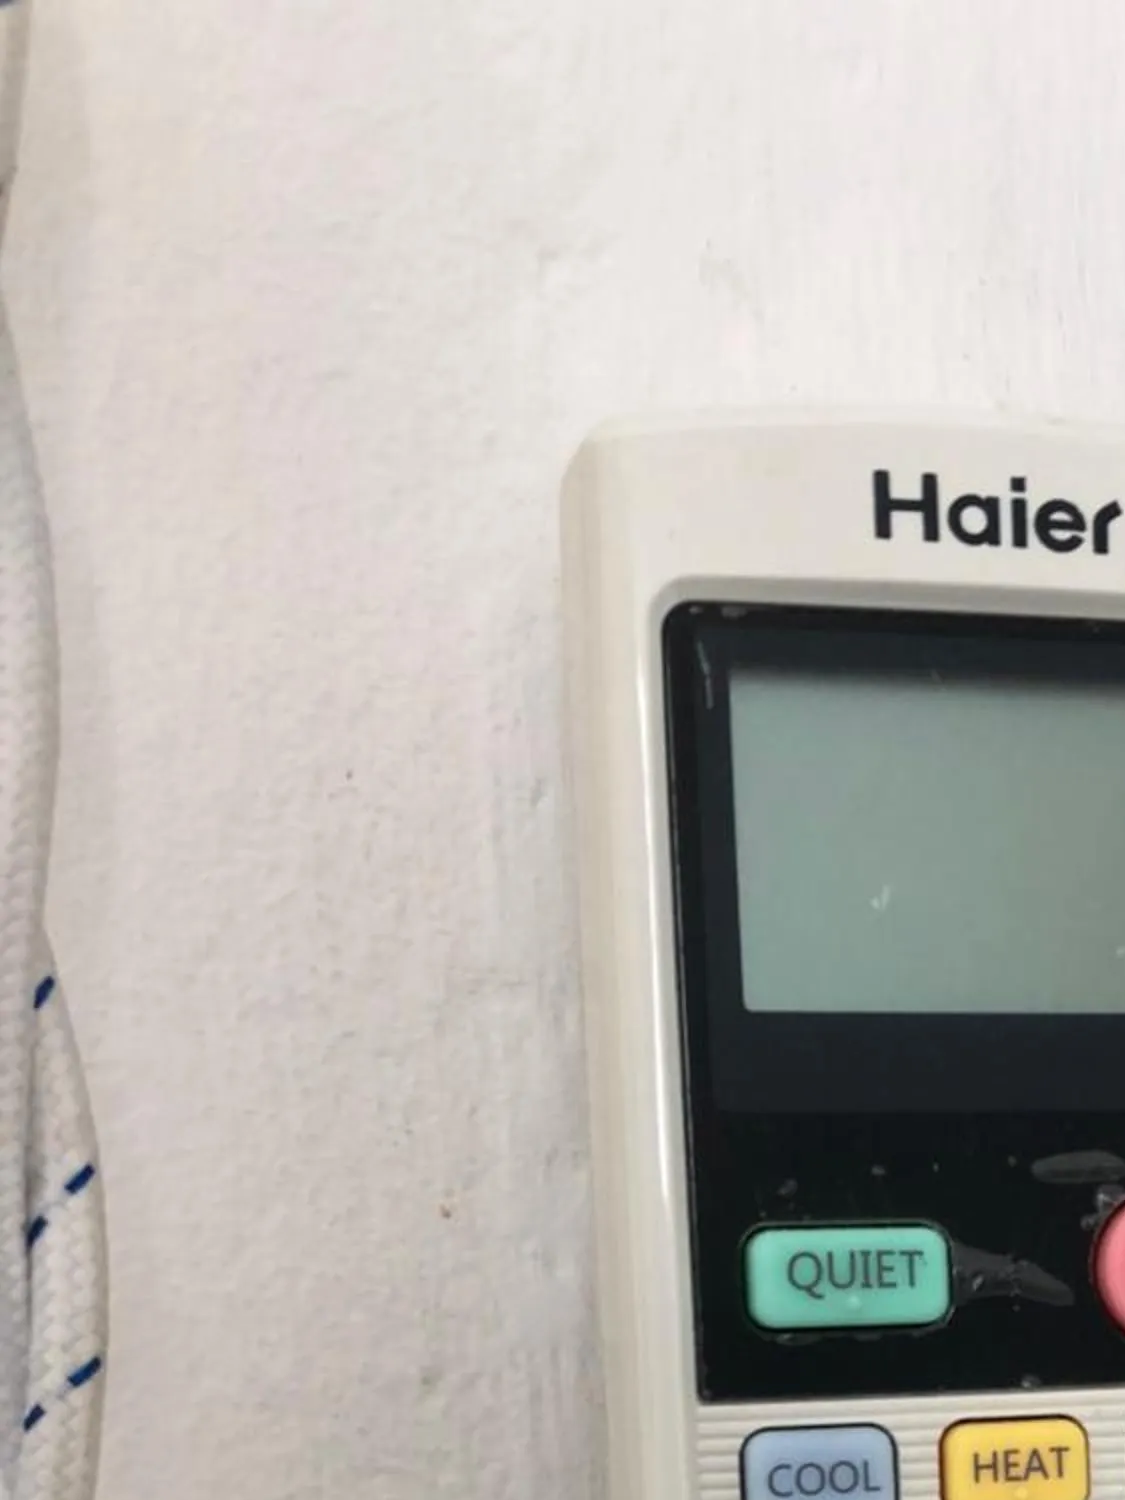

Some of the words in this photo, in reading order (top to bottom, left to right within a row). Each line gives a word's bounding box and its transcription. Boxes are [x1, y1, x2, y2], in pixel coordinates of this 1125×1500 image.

[872, 470, 1123, 554] Haier
[787, 1250, 924, 1298] QUIET
[766, 1460, 881, 1497] COOL
[972, 1447, 1070, 1483] HEAT
